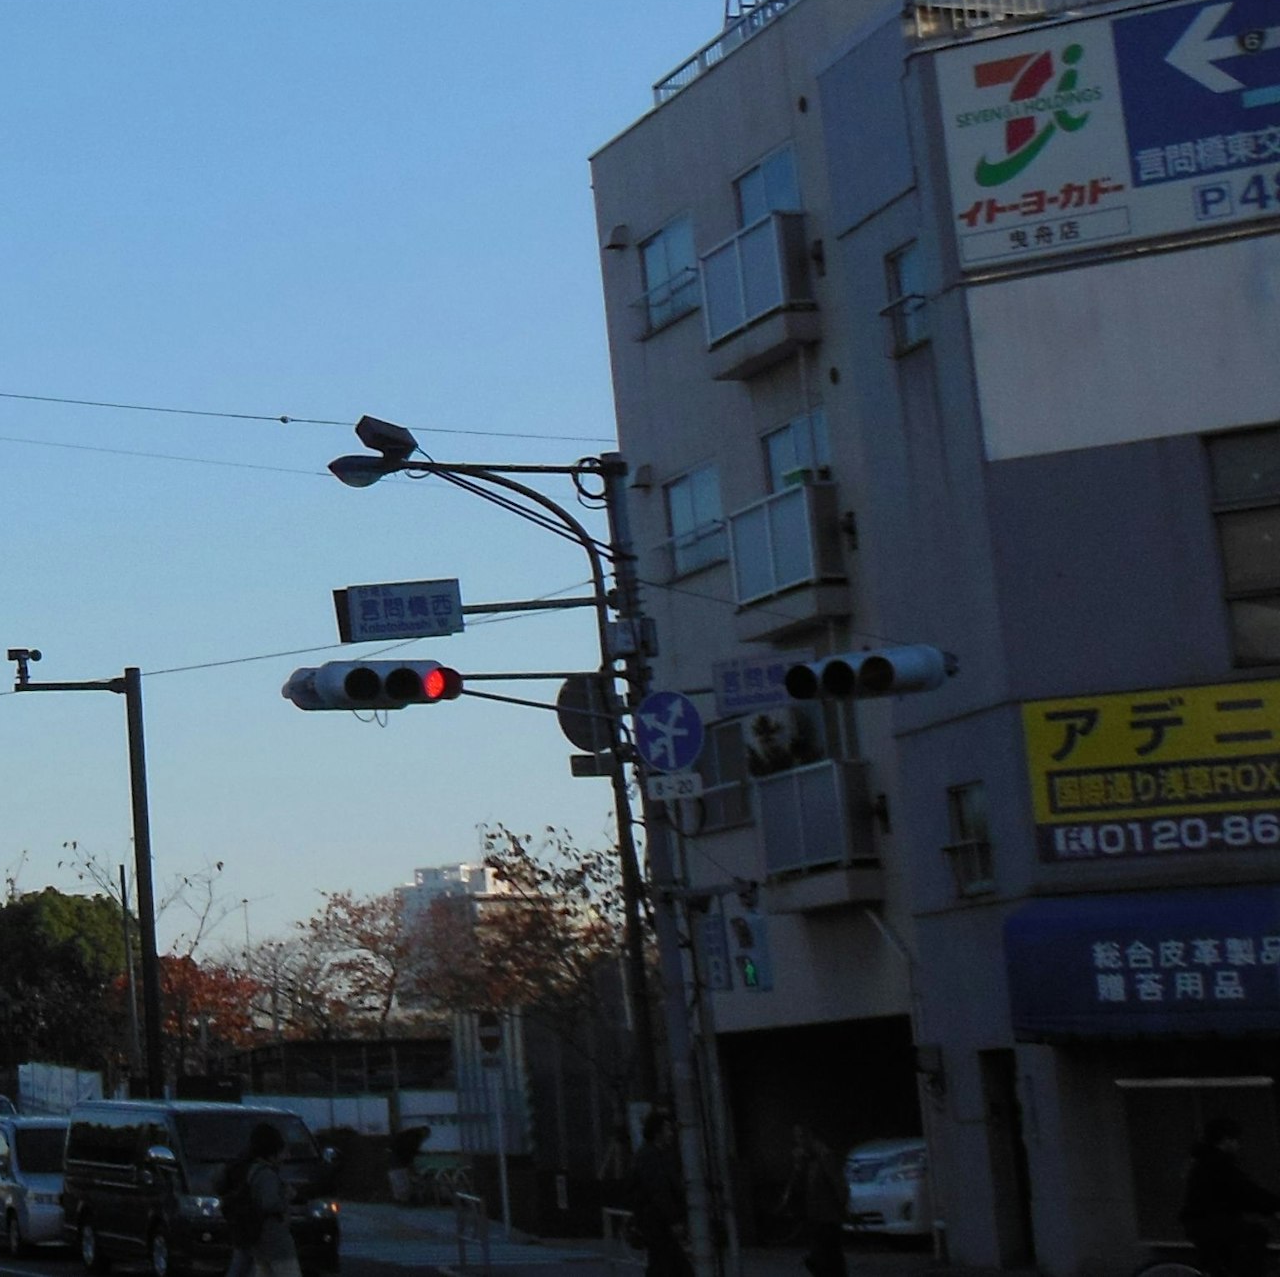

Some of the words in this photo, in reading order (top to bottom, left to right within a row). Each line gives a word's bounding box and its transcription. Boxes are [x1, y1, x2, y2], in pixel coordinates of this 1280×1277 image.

[957, 177, 1124, 227] イトーヨーカドー
[1009, 221, 1081, 249] 曳舟店
